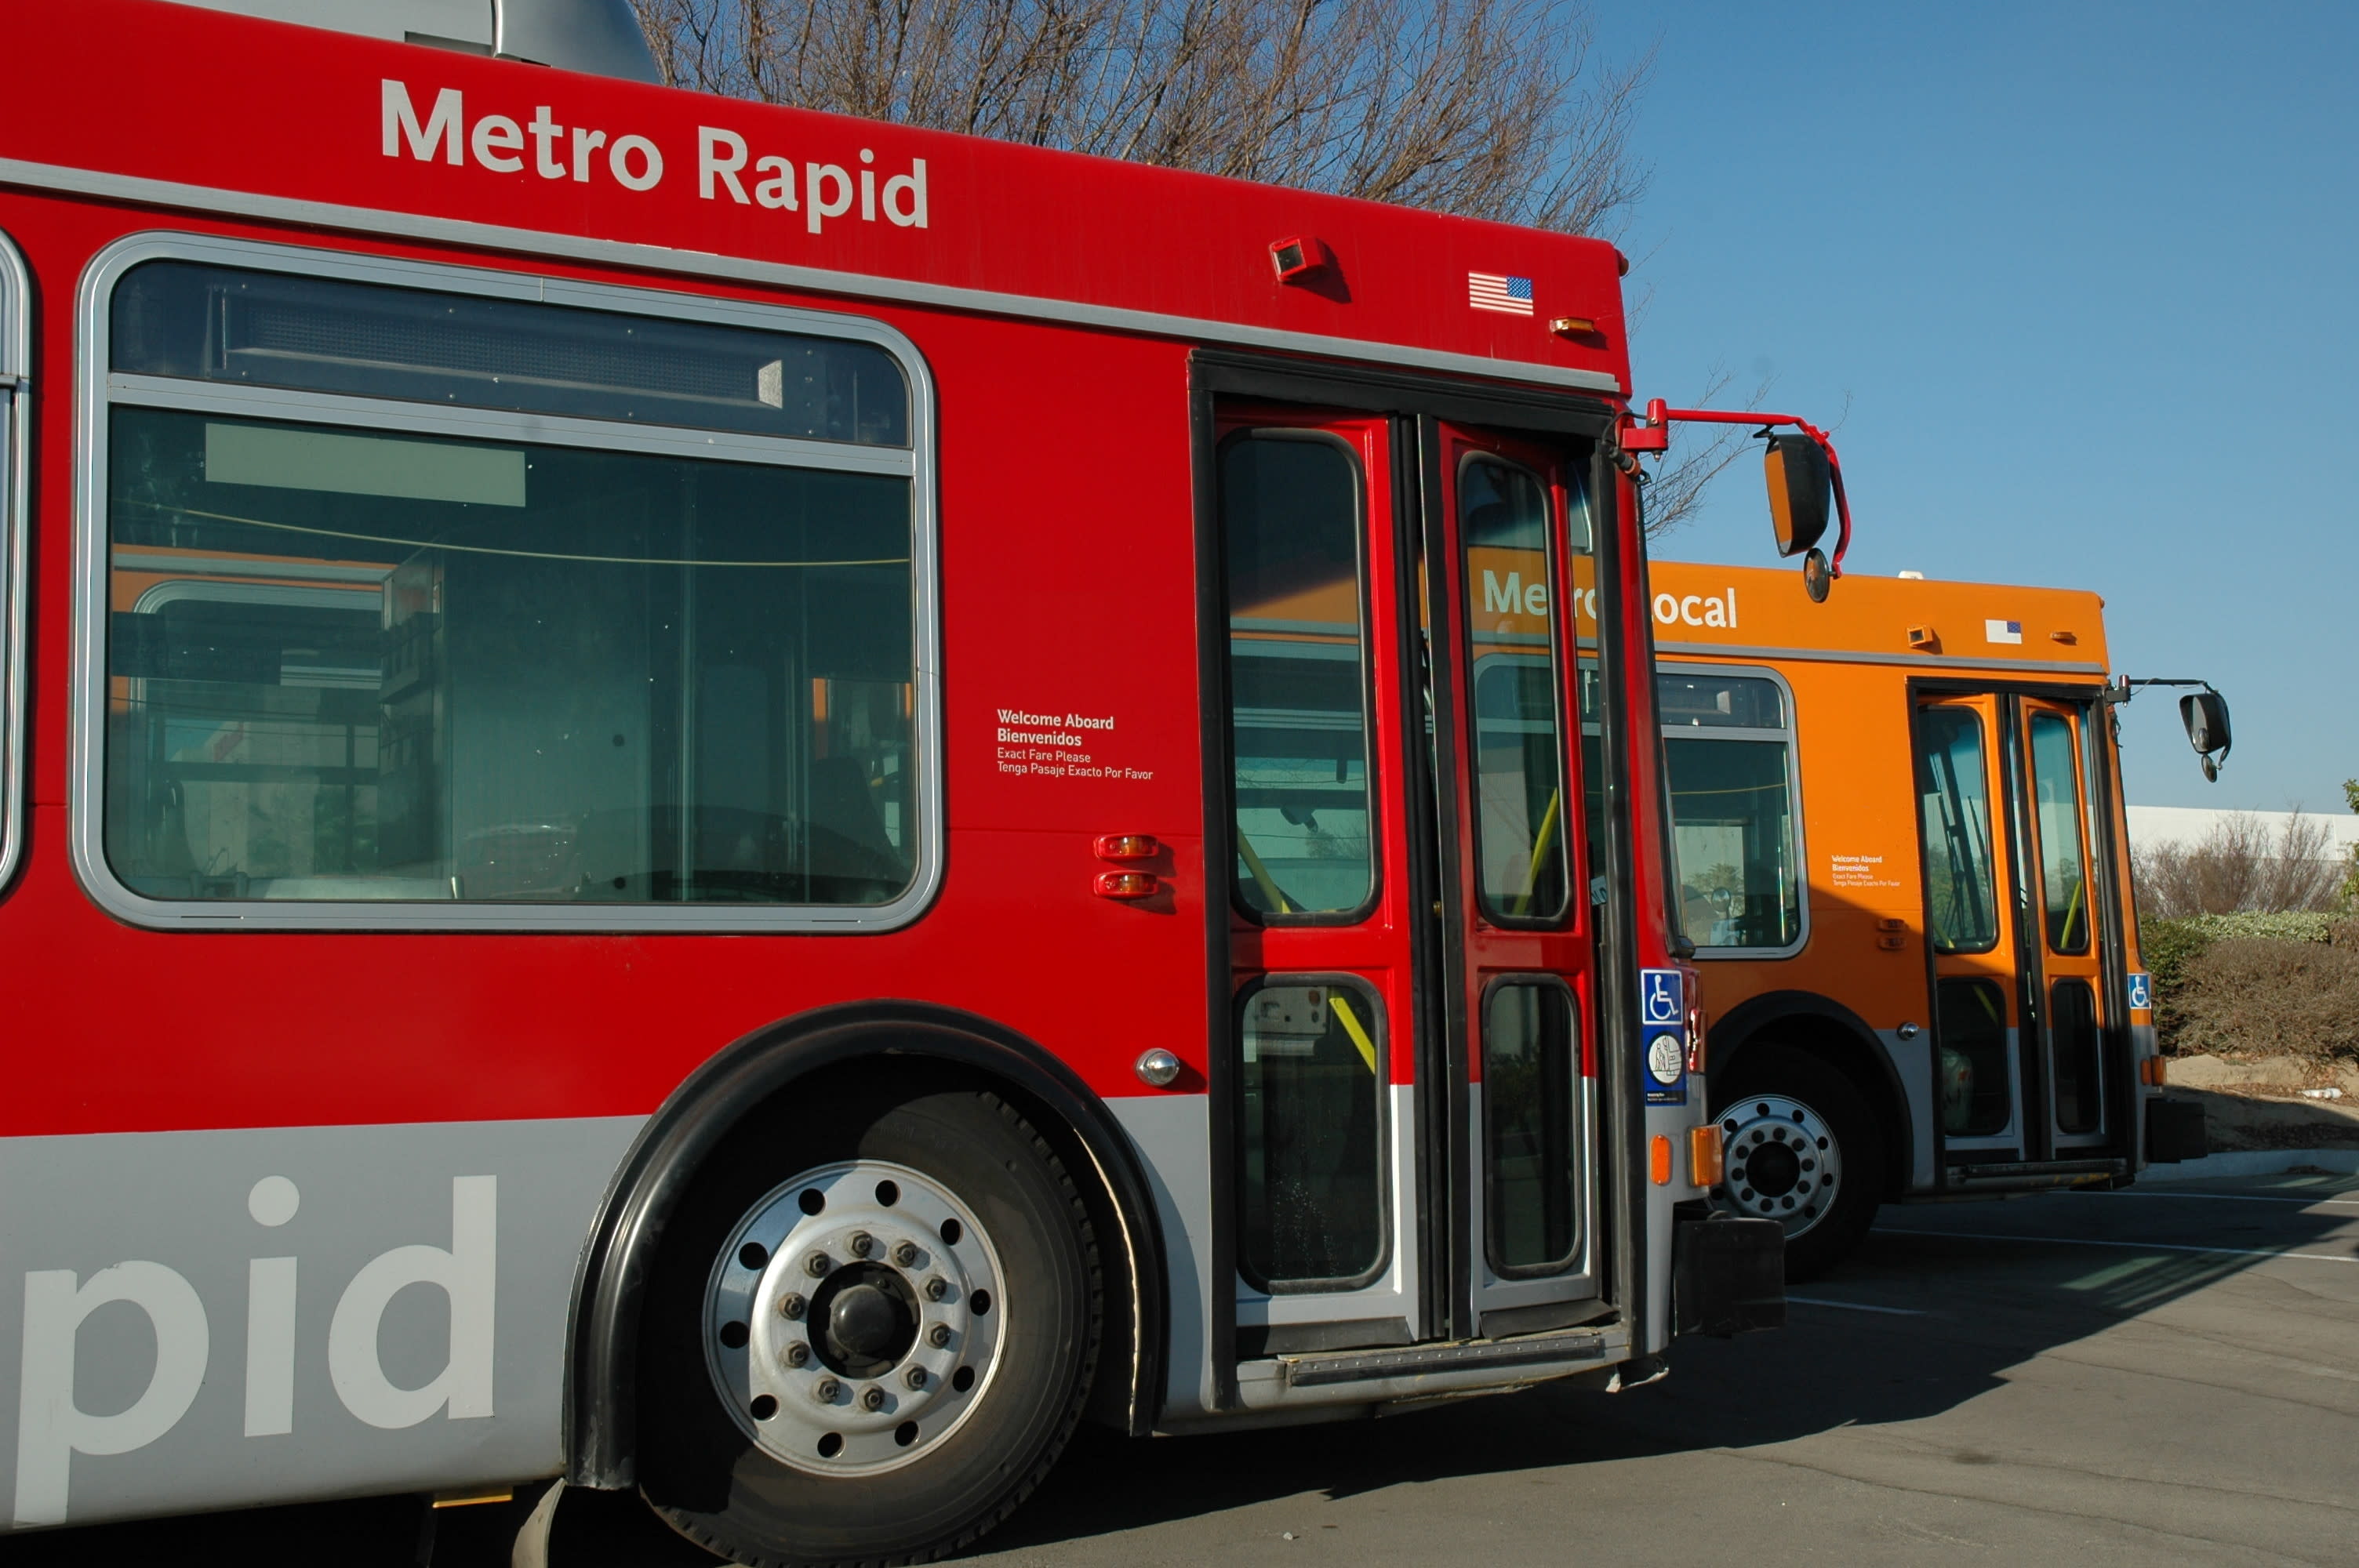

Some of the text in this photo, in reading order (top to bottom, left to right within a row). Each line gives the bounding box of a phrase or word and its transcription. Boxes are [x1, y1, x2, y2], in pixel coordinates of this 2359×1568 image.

[381, 78, 928, 234] Metro Rapid
[1651, 587, 1737, 628] ocal
[997, 709, 1114, 730] Welcome Aboard
[998, 728, 1081, 746] Bienvenidos
[998, 747, 1091, 763] Exact Fare Please
[998, 761, 1154, 780] Tenga Pasaje Exacto Por Favor
[1832, 863, 1870, 872] Bienvenidos
[12, 1174, 497, 1530] pid
